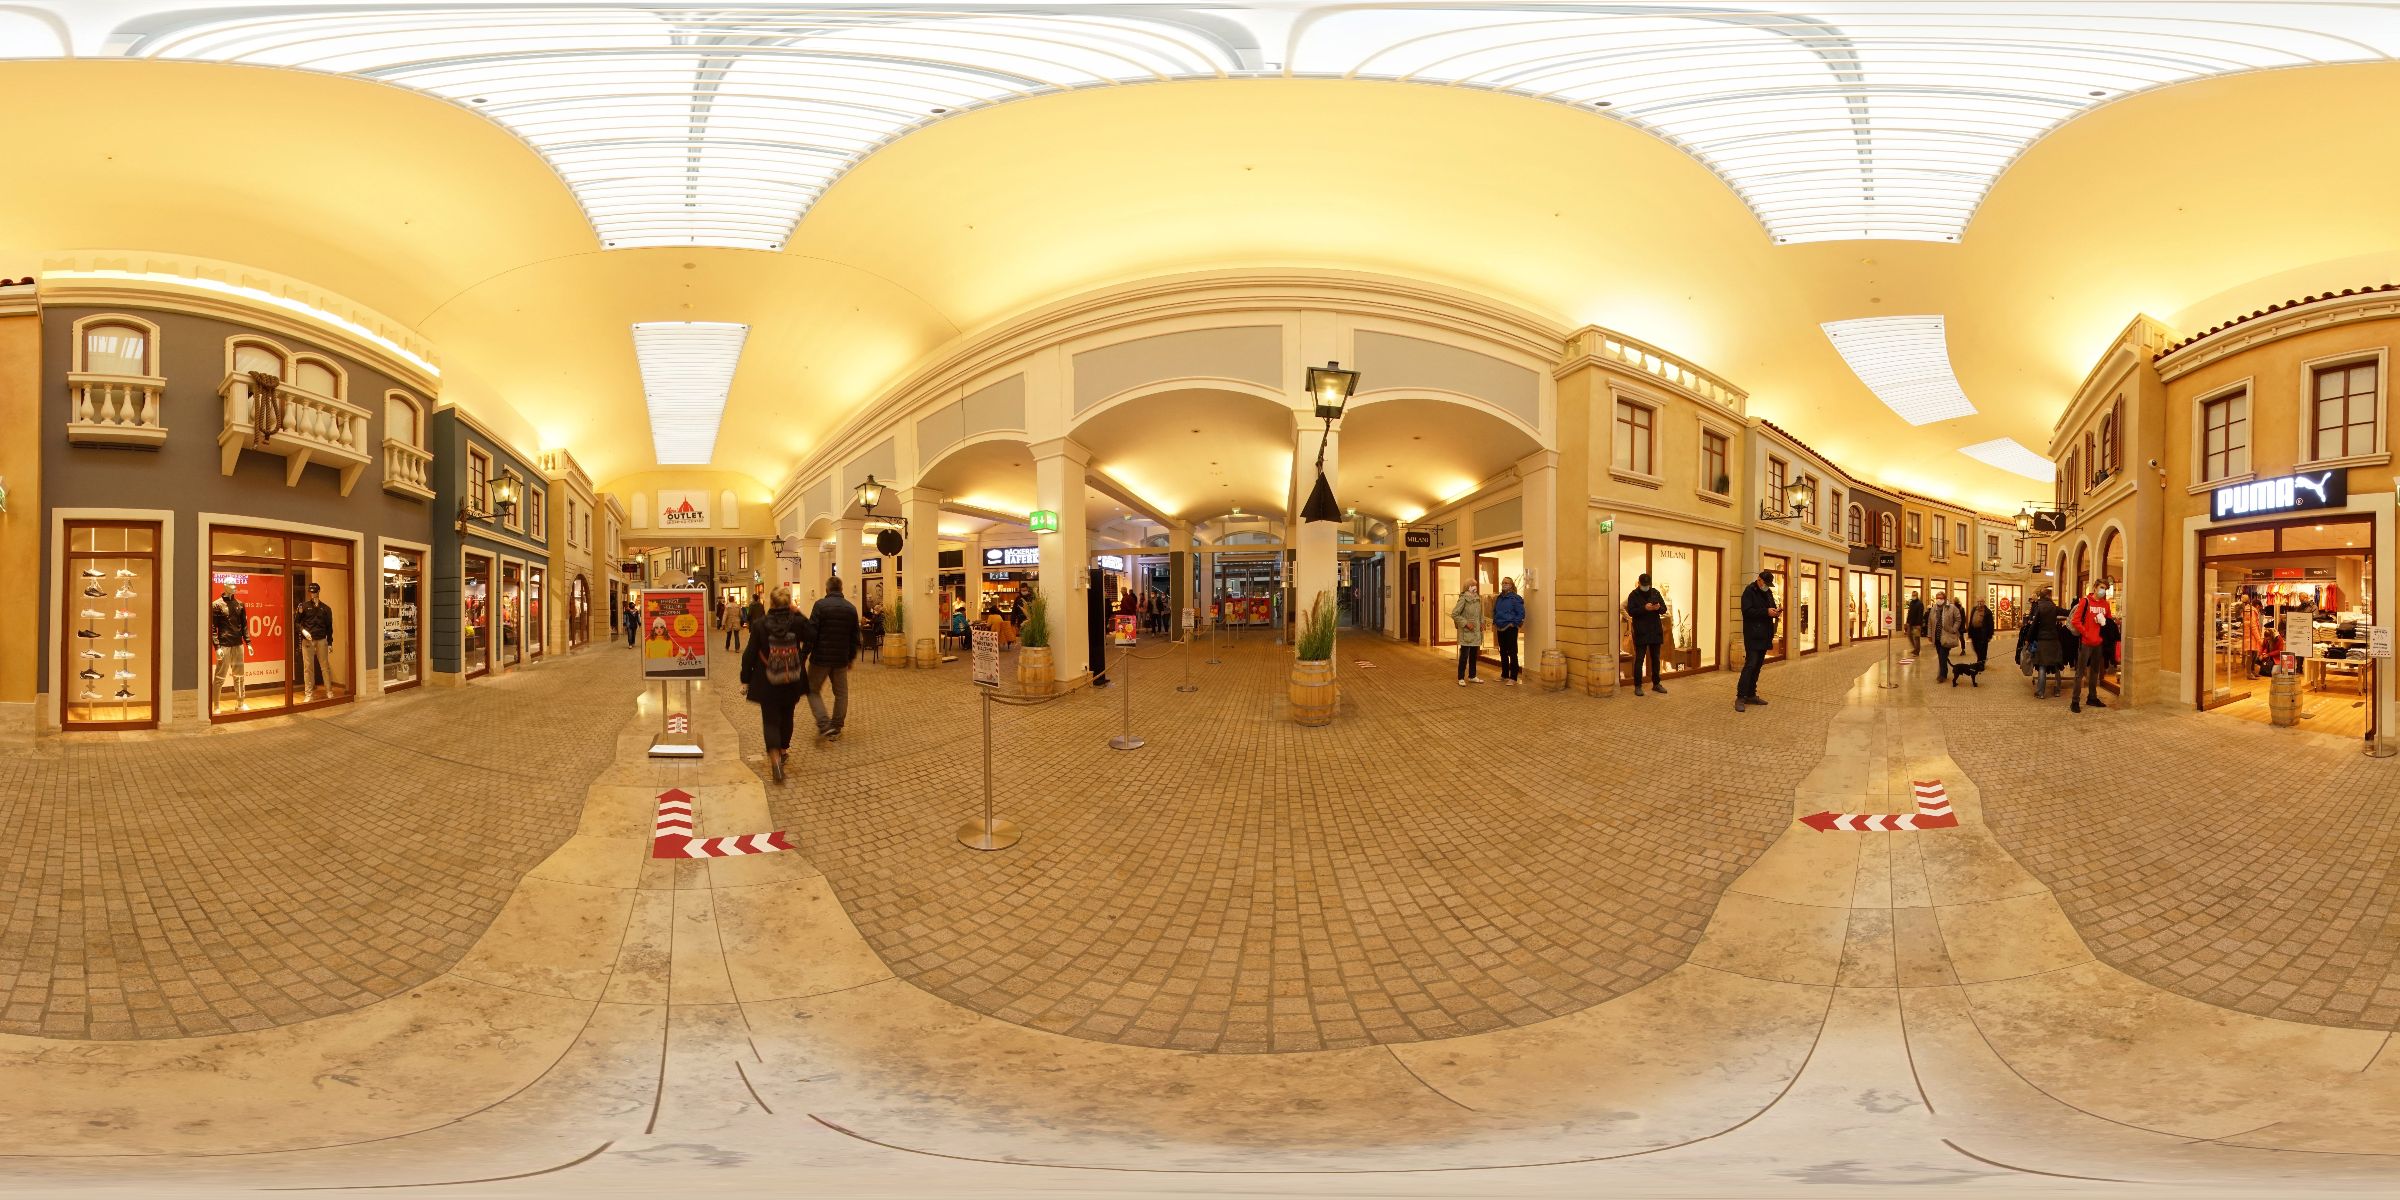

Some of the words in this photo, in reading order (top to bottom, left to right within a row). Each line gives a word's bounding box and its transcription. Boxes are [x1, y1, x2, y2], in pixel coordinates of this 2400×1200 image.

[2217, 477, 2294, 517] PUMA
[667, 511, 703, 520] OUTLET
[1660, 549, 1686, 560] MILANI
[246, 615, 282, 638] 0%
